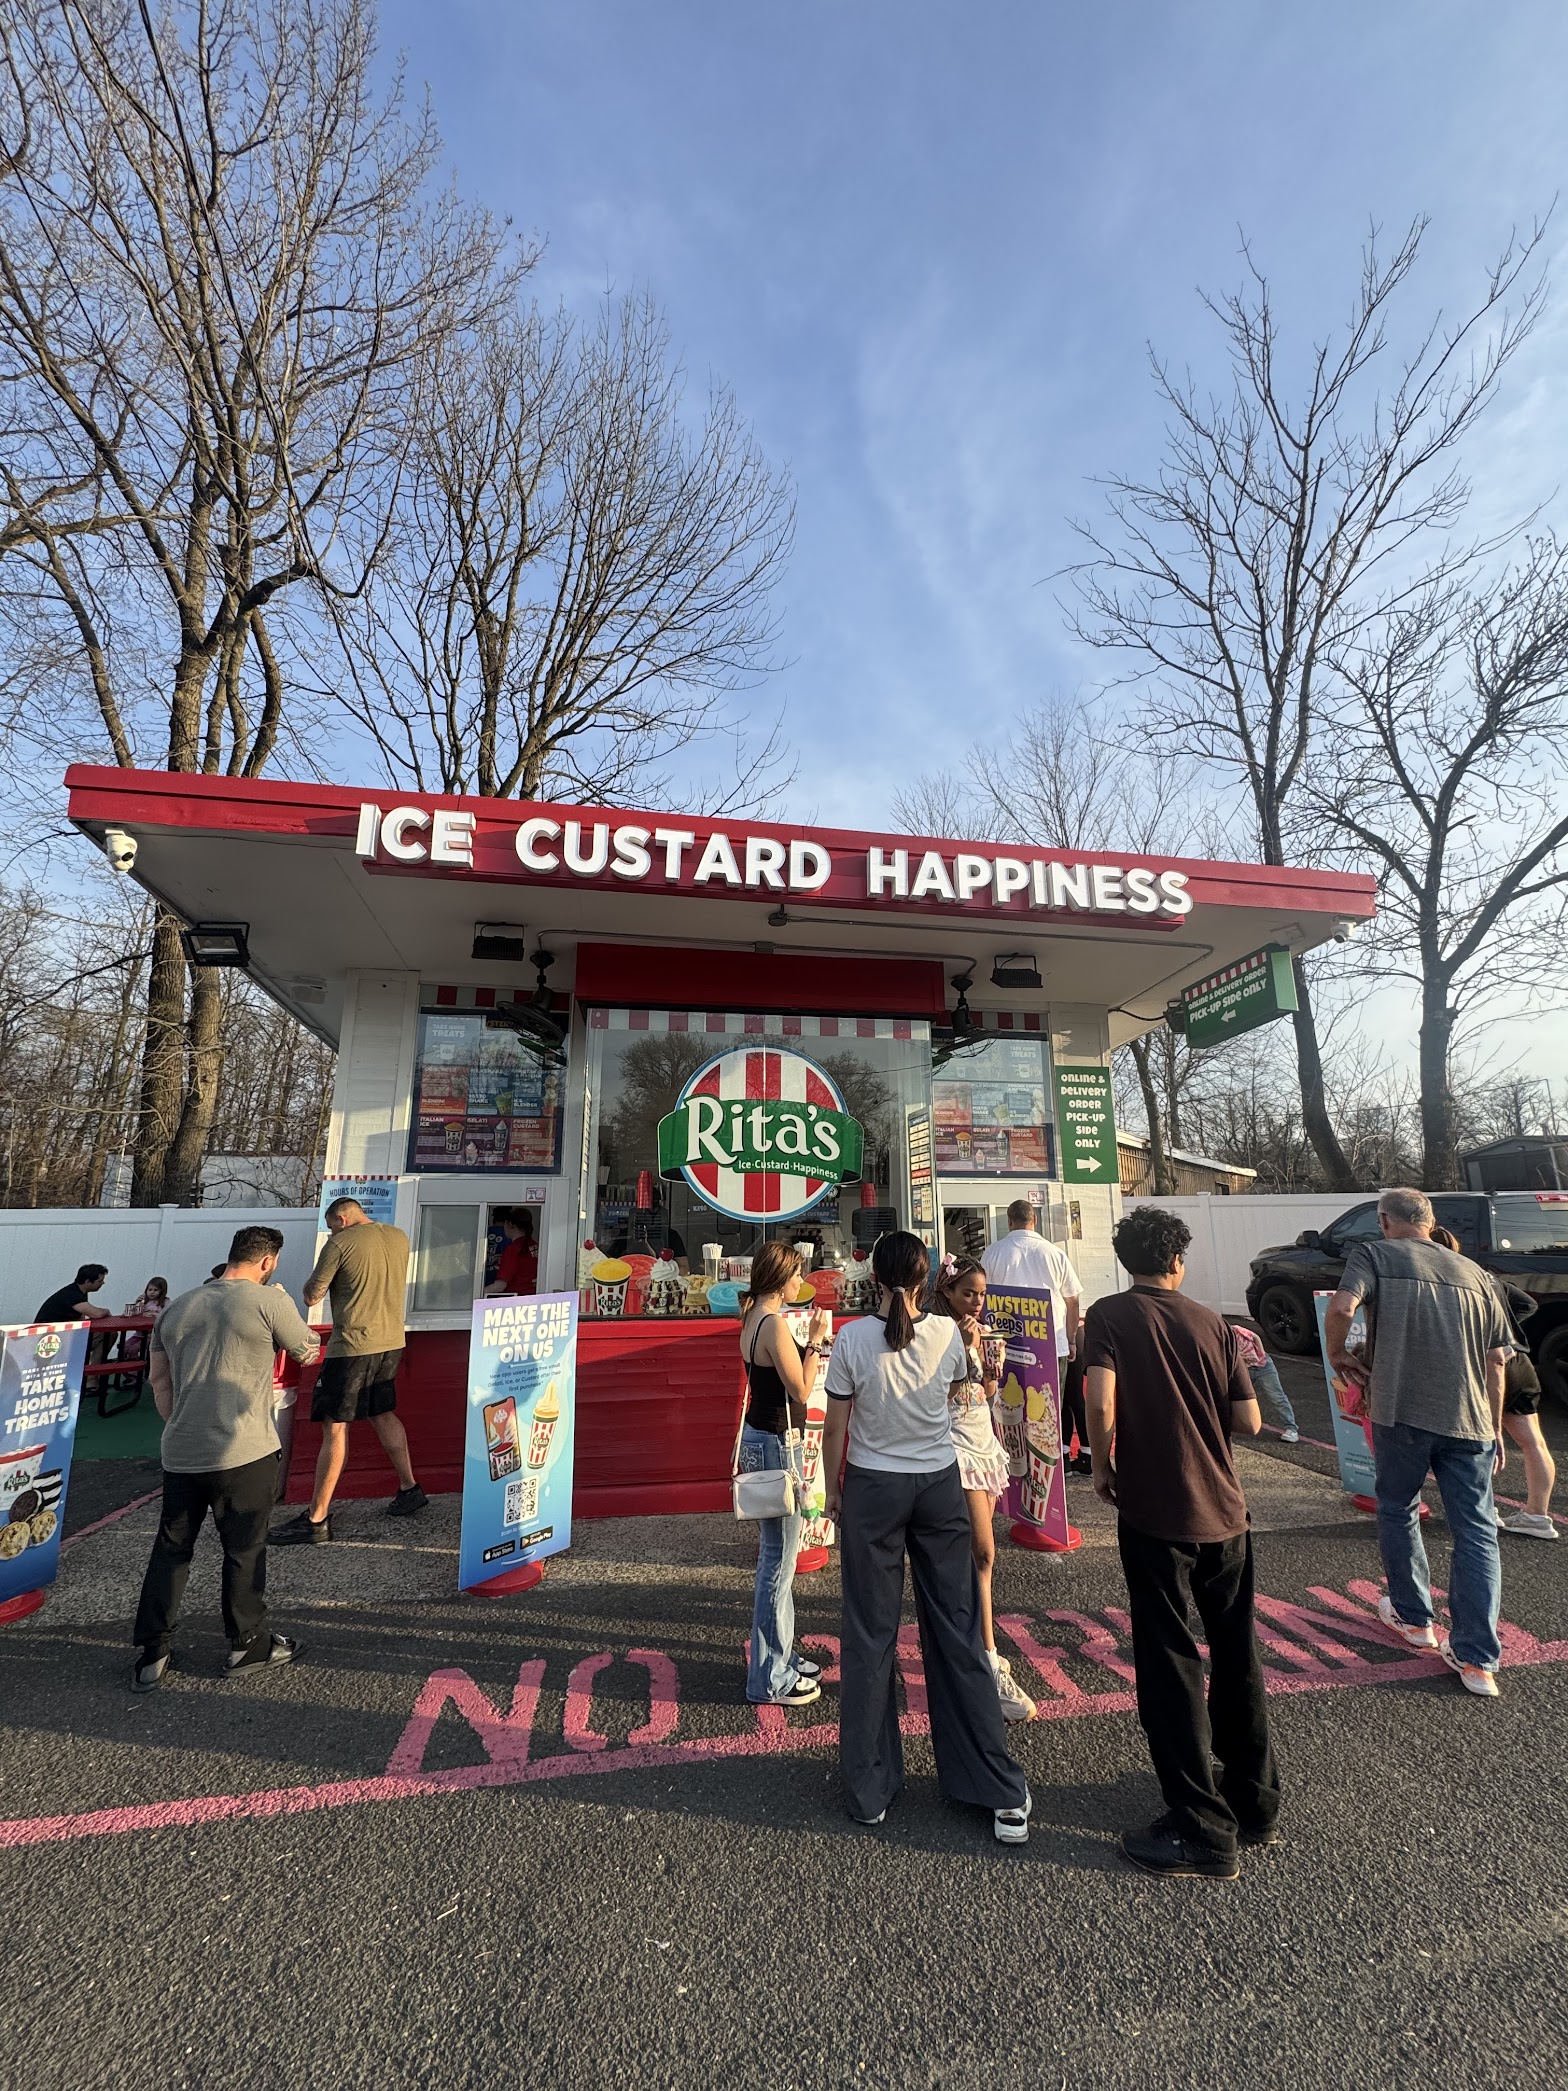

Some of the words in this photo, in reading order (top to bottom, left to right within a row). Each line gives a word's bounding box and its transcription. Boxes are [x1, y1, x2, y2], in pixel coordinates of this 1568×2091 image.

[355, 802, 476, 869] ICE
[515, 817, 832, 893] CUSTARD
[867, 846, 1193, 918] HAPPINESS
[1188, 995, 1209, 1010] ONLINE
[1209, 992, 1214, 1000] &
[1214, 978, 1243, 996] DELIVERY
[1244, 965, 1267, 983] ORDER
[1190, 1001, 1221, 1023] PICK-UP
[1222, 991, 1241, 1008] SIDE
[1243, 978, 1267, 997] ONLY
[432, 1030, 465, 1038] TREATS
[1061, 1074, 1096, 1084] ONLINE
[1061, 1087, 1107, 1097] DELIVERY
[1069, 1100, 1101, 1109] ORDER
[1066, 1112, 1106, 1122] PICK-UP
[685, 1096, 840, 1165] Rita's
[1076, 1126, 1098, 1135] SIDE
[1075, 1139, 1100, 1148] ONLY
[330, 1187, 349, 1197] HOURS
[351, 1186, 358, 1195] OF
[359, 1186, 390, 1197] OPERATION
[483, 1305, 538, 1328] MAKE
[540, 1301, 571, 1320] THE
[986, 1294, 1049, 1318] MYSTERY
[482, 1324, 534, 1348] NEXT
[536, 1319, 570, 1340] ONE
[986, 1312, 1023, 1334] Peeps
[1024, 1320, 1048, 1340] ICE
[38, 1342, 60, 1352] Rita's
[499, 1343, 529, 1363] ON
[532, 1338, 554, 1360] US
[21, 1375, 66, 1397] TAKE
[14, 1390, 66, 1415] HOME
[4, 1406, 69, 1434] TREATS
[7, 1475, 29, 1488] Rita's
[530, 1535, 543, 1544] Google
[805, 1533, 823, 1545] Rita's
[502, 1546, 513, 1554] Store
[387, 1649, 680, 1776] NO
